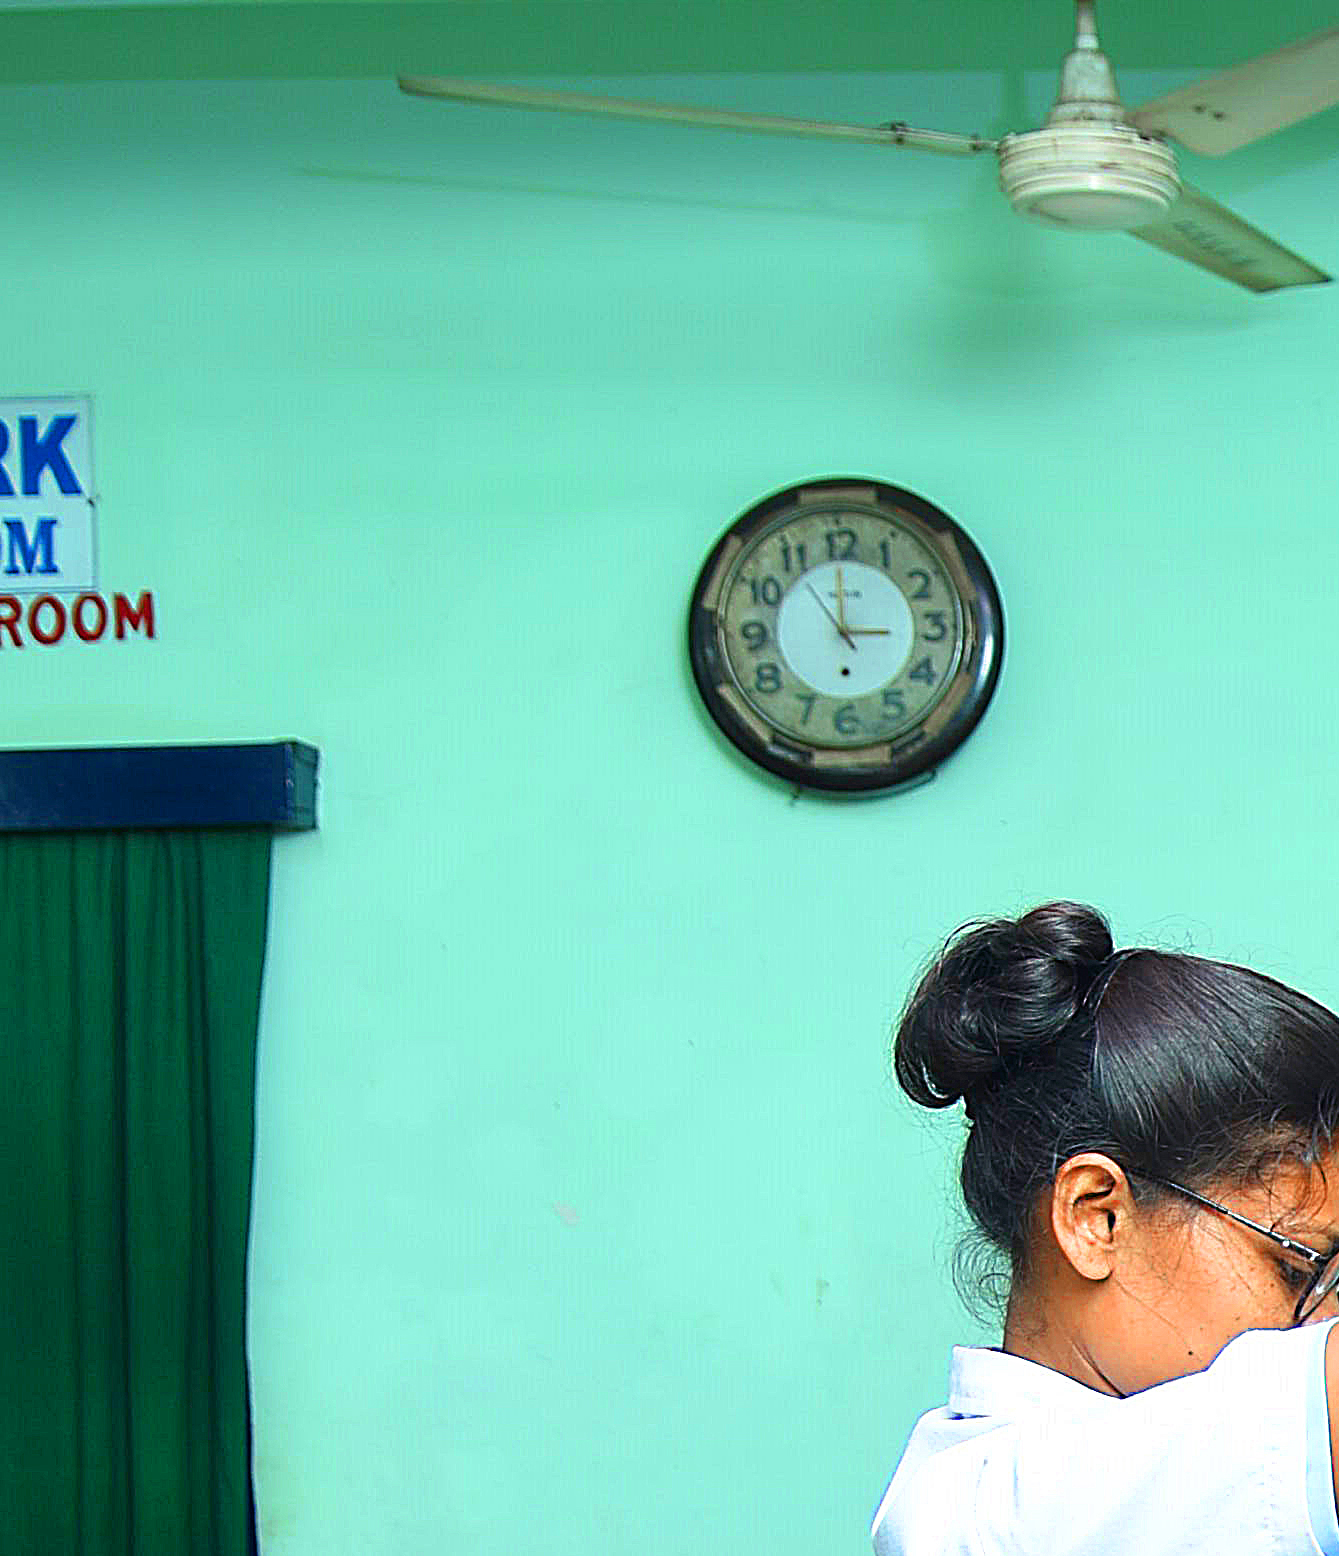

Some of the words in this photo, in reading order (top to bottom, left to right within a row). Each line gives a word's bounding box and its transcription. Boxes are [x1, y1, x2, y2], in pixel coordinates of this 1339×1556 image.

[780, 534, 808, 572] 11
[825, 528, 857, 560] 12
[750, 577, 780, 606] 10
[909, 568, 931, 599] 2
[742, 621, 767, 650] 9
[923, 610, 947, 641] 3
[756, 662, 781, 693] 8
[909, 657, 936, 685] 4
[796, 693, 818, 724] 7
[835, 704, 860, 735] 6
[883, 689, 906, 720] 5
